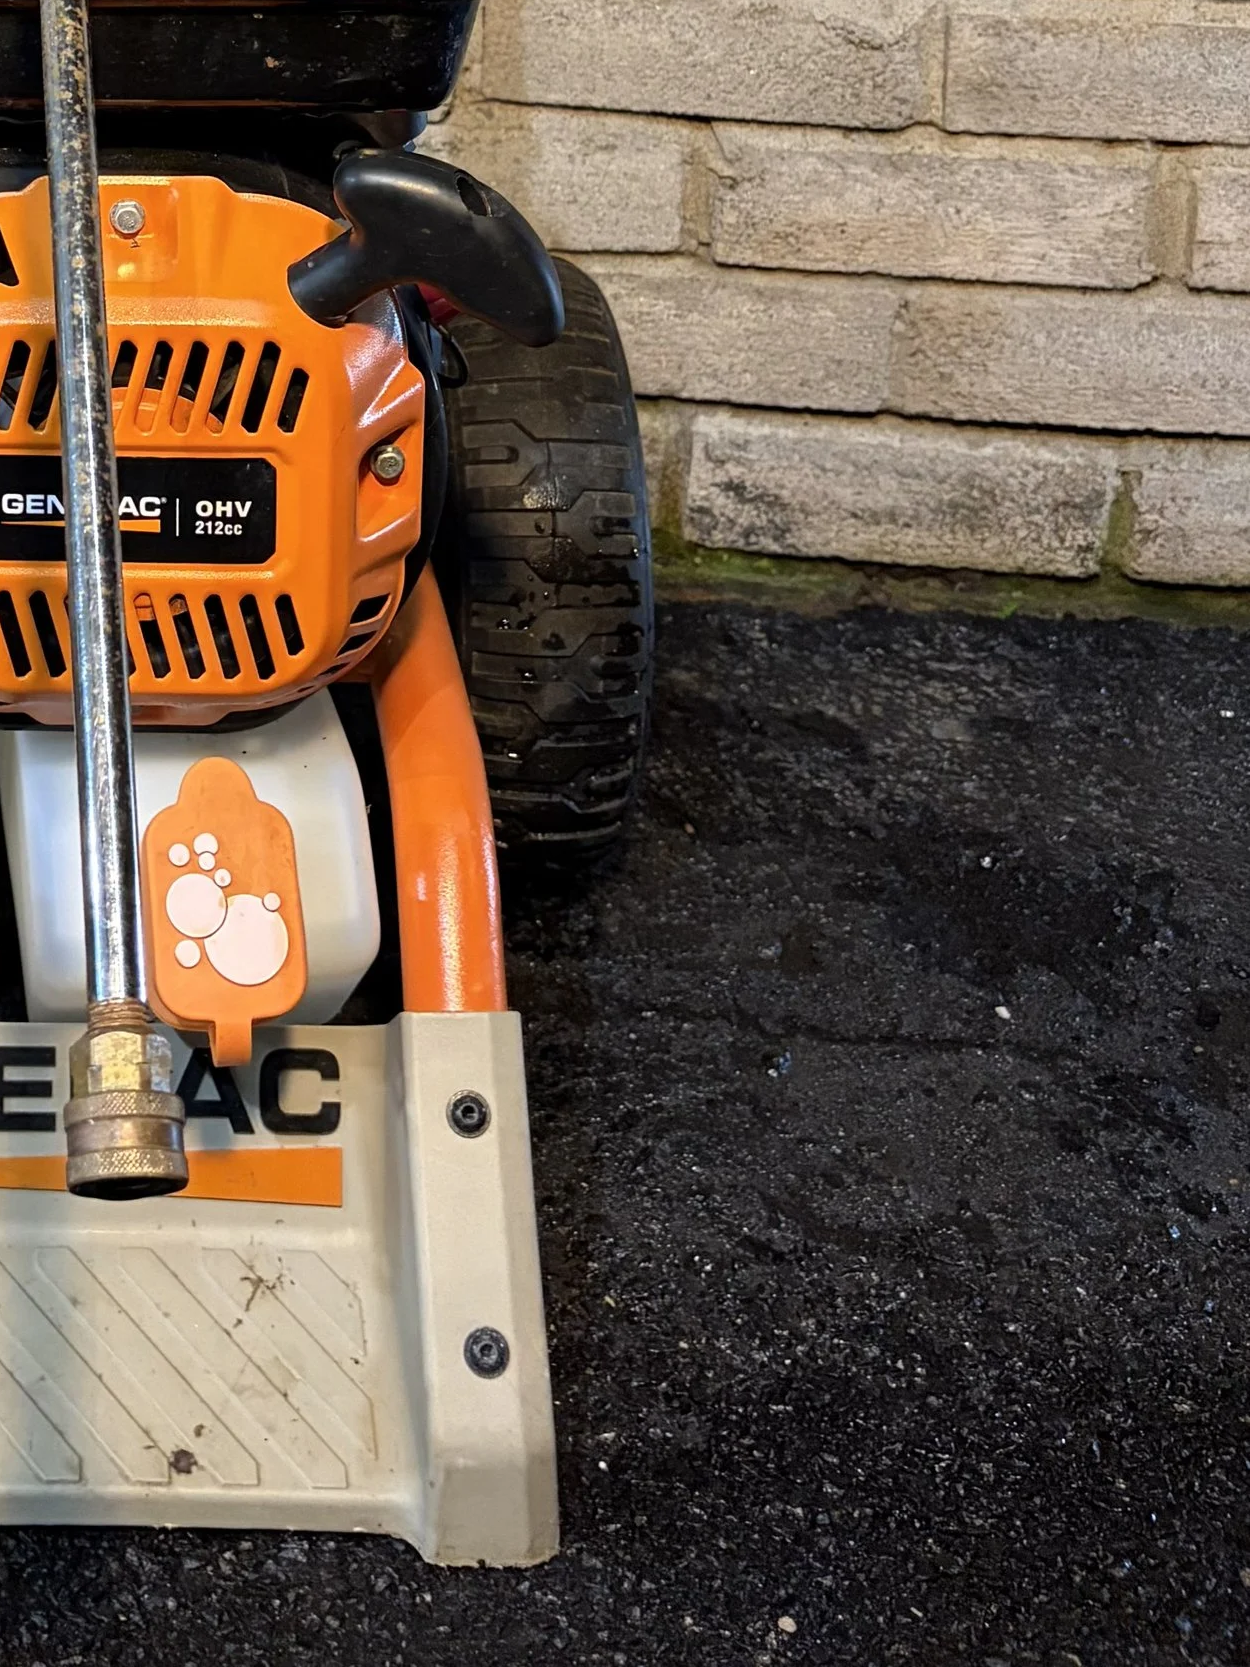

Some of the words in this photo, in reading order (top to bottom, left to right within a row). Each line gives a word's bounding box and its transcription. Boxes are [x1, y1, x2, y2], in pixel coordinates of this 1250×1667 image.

[1, 493, 162, 517] GENAC
[195, 500, 252, 518] OHV
[194, 520, 243, 536] 212cc
